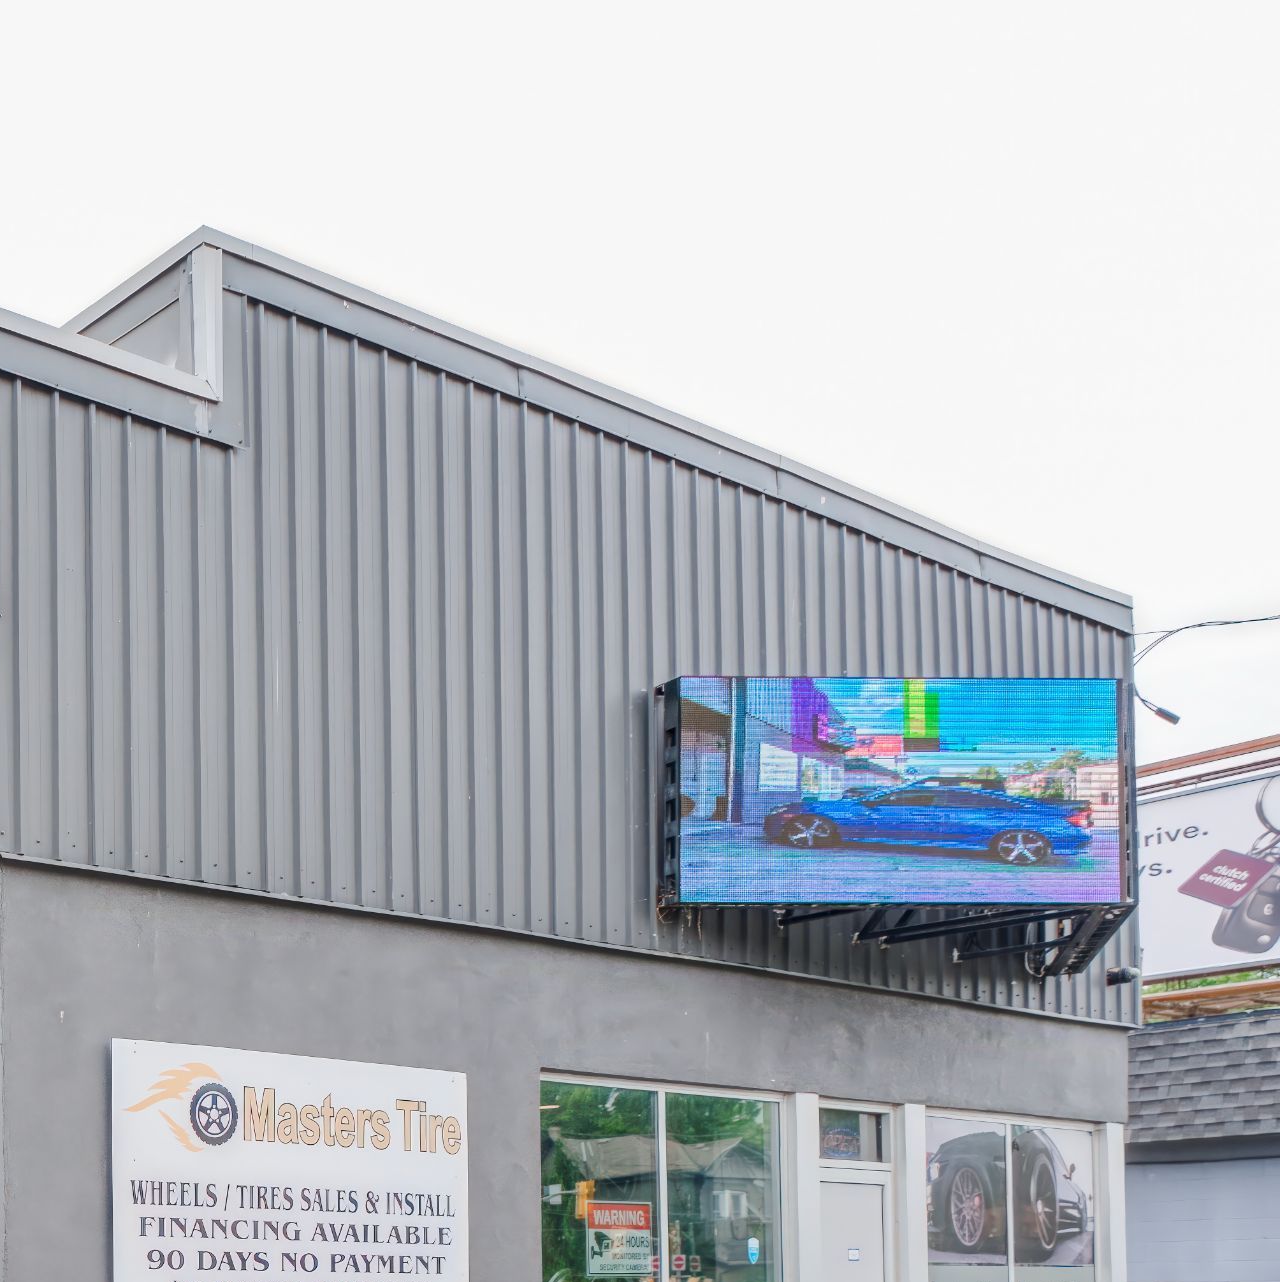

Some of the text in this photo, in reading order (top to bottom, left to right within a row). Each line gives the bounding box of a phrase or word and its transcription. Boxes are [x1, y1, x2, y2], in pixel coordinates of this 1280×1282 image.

[1198, 873, 1248, 892] certified
[1212, 864, 1250, 882] clutch
[243, 1085, 462, 1155] Masters Tire
[130, 1179, 456, 1218] WHEELS / TIRES SALES & INSTALL
[593, 1210, 645, 1226] WARNING
[138, 1216, 453, 1246] FINANCING AVAILABLE
[615, 1235, 649, 1248] 24 HOURS
[146, 1249, 446, 1275] 90 DAYS NO PAYMENT
[612, 1252, 642, 1260] MONITORED
